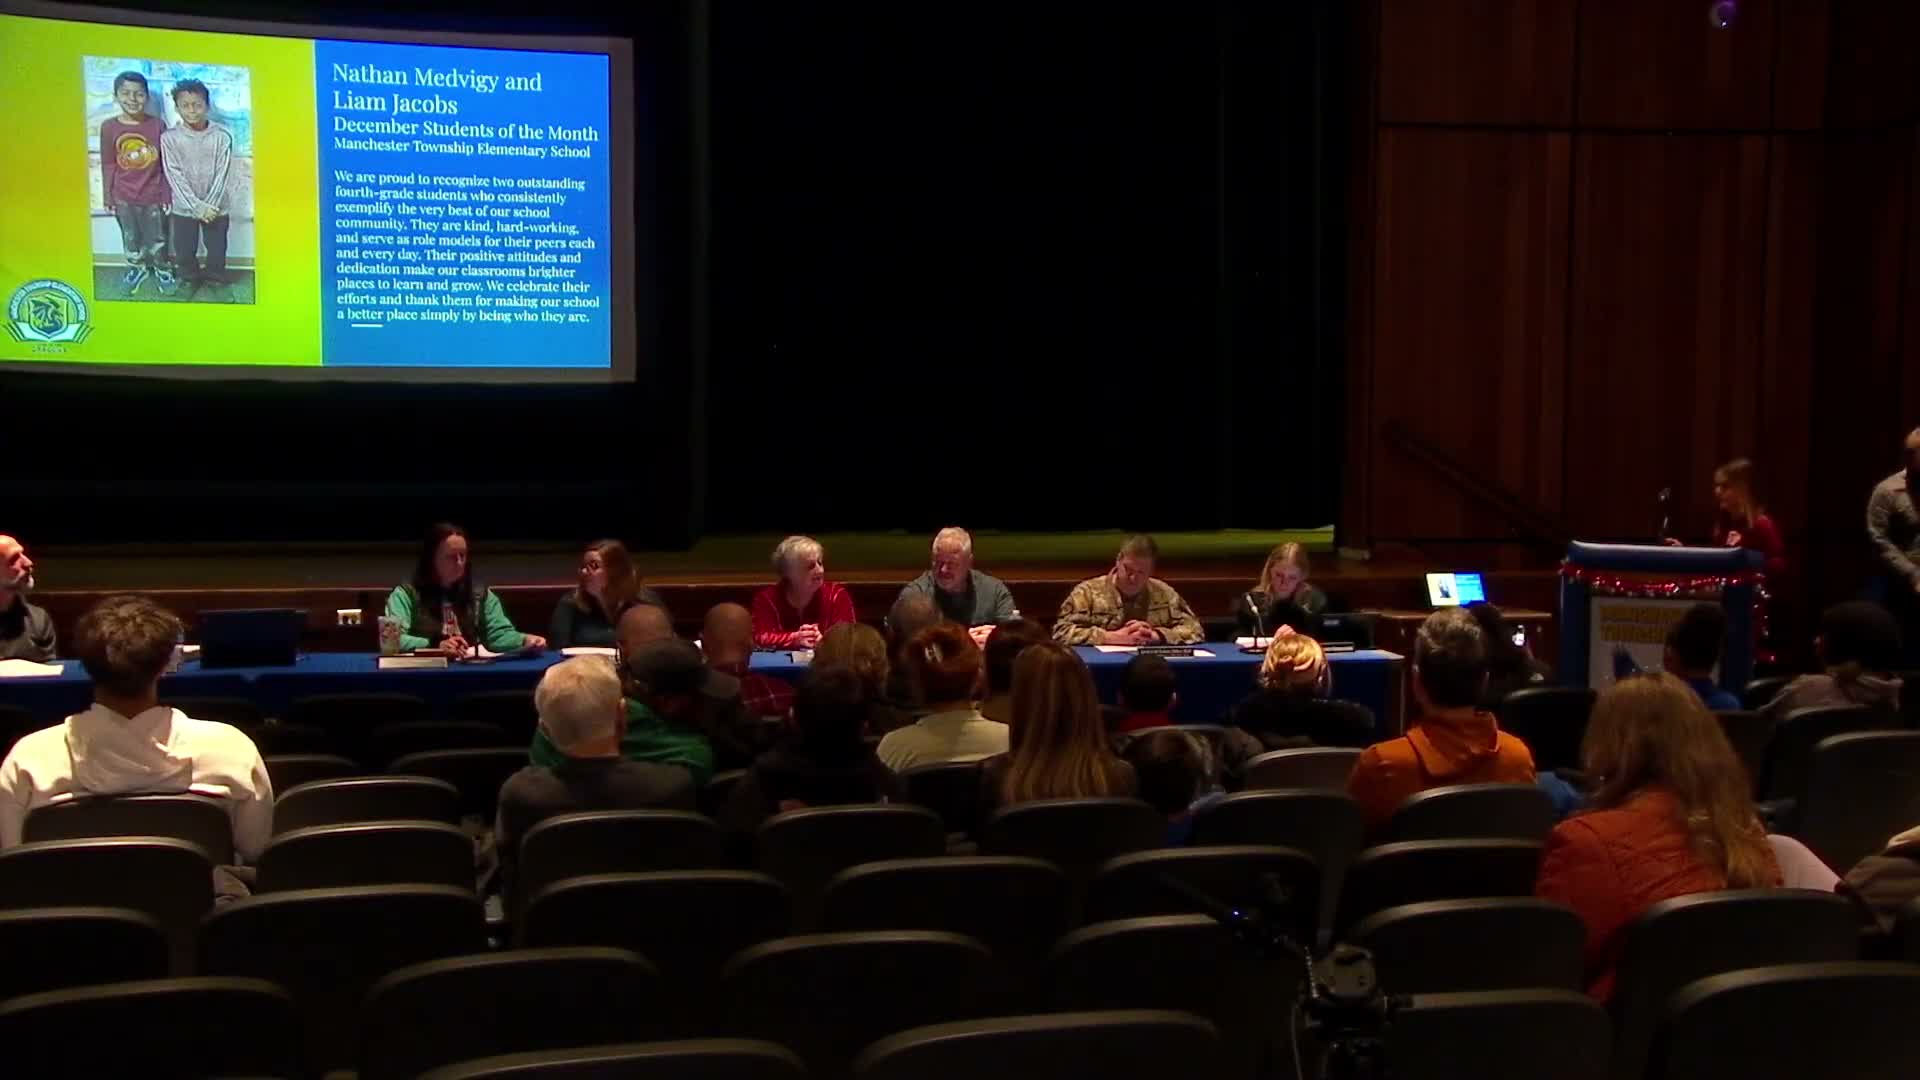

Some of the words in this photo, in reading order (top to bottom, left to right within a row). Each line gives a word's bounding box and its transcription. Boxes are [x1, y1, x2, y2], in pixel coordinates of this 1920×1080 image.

[333, 63, 408, 85] Nathan
[414, 67, 499, 93] Medvigy
[504, 72, 543, 91] and
[333, 90, 386, 111] Liam
[392, 93, 458, 116] Jacobs
[334, 116, 419, 135] December
[422, 120, 494, 138] Students
[498, 123, 516, 139] of
[518, 123, 544, 139] the
[548, 125, 599, 142] Month
[334, 137, 410, 151] Manchester
[412, 140, 474, 156] Township
[477, 142, 548, 159] Elementary
[550, 145, 591, 158] School
[335, 169, 353, 182] We
[356, 173, 376, 183] are
[379, 172, 415, 185] proud
[418, 174, 430, 185] to
[433, 174, 490, 188] recognize
[493, 176, 515, 188] two
[517, 177, 585, 191] outstanding
[336, 185, 414, 200] fourth-grade
[416, 188, 467, 201] students
[470, 189, 495, 202] who
[497, 191, 566, 206] consistently
[335, 201, 394, 216] exemplify
[397, 202, 417, 215] the
[419, 206, 445, 217] very
[448, 204, 473, 216] best
[475, 205, 489, 217] of
[490, 207, 511, 217] our
[513, 206, 550, 218] school
[335, 217, 407, 232] community.
[410, 218, 439, 232] They
[442, 222, 461, 231] are
[464, 219, 494, 233] kind,
[496, 221, 580, 236] hard-working,
[335, 232, 359, 244] and
[361, 235, 394, 245] serve
[396, 236, 410, 245] as
[413, 233, 435, 246] role
[439, 234, 481, 247] models
[484, 235, 500, 247] for
[504, 236, 532, 248] their
[535, 239, 566, 250] peers
[568, 237, 595, 249] each
[336, 246, 359, 259] and
[362, 249, 395, 262] every
[397, 248, 421, 262] day.
[424, 249, 457, 261] Their
[460, 250, 505, 263] positive
[507, 251, 557, 263] attitudes
[560, 252, 582, 263] and
[336, 261, 400, 275] dedication
[403, 263, 435, 275] make
[437, 266, 459, 276] our
[461, 264, 526, 277] classrooms
[528, 265, 576, 279] brighter
[337, 277, 375, 291] places
[378, 279, 390, 289] to
[393, 278, 424, 290] learn
[426, 279, 449, 290] and
[451, 281, 483, 293] grow.
[486, 280, 505, 291] We
[506, 280, 560, 293] celebrate
[562, 281, 590, 293] their
[337, 292, 377, 305] efforts
[379, 293, 402, 305] and
[405, 293, 440, 306] thank
[442, 294, 472, 306] them
[475, 295, 493, 307] for
[495, 295, 538, 309] making
[540, 298, 562, 308] our
[563, 296, 600, 308] school
[337, 309, 345, 319] a
[347, 307, 384, 320] better
[386, 308, 418, 322] place
[421, 309, 460, 323] simply
[462, 309, 477, 323] by
[479, 309, 512, 323] being
[514, 310, 539, 322] who
[541, 311, 566, 324] they
[568, 314, 591, 323] are.
